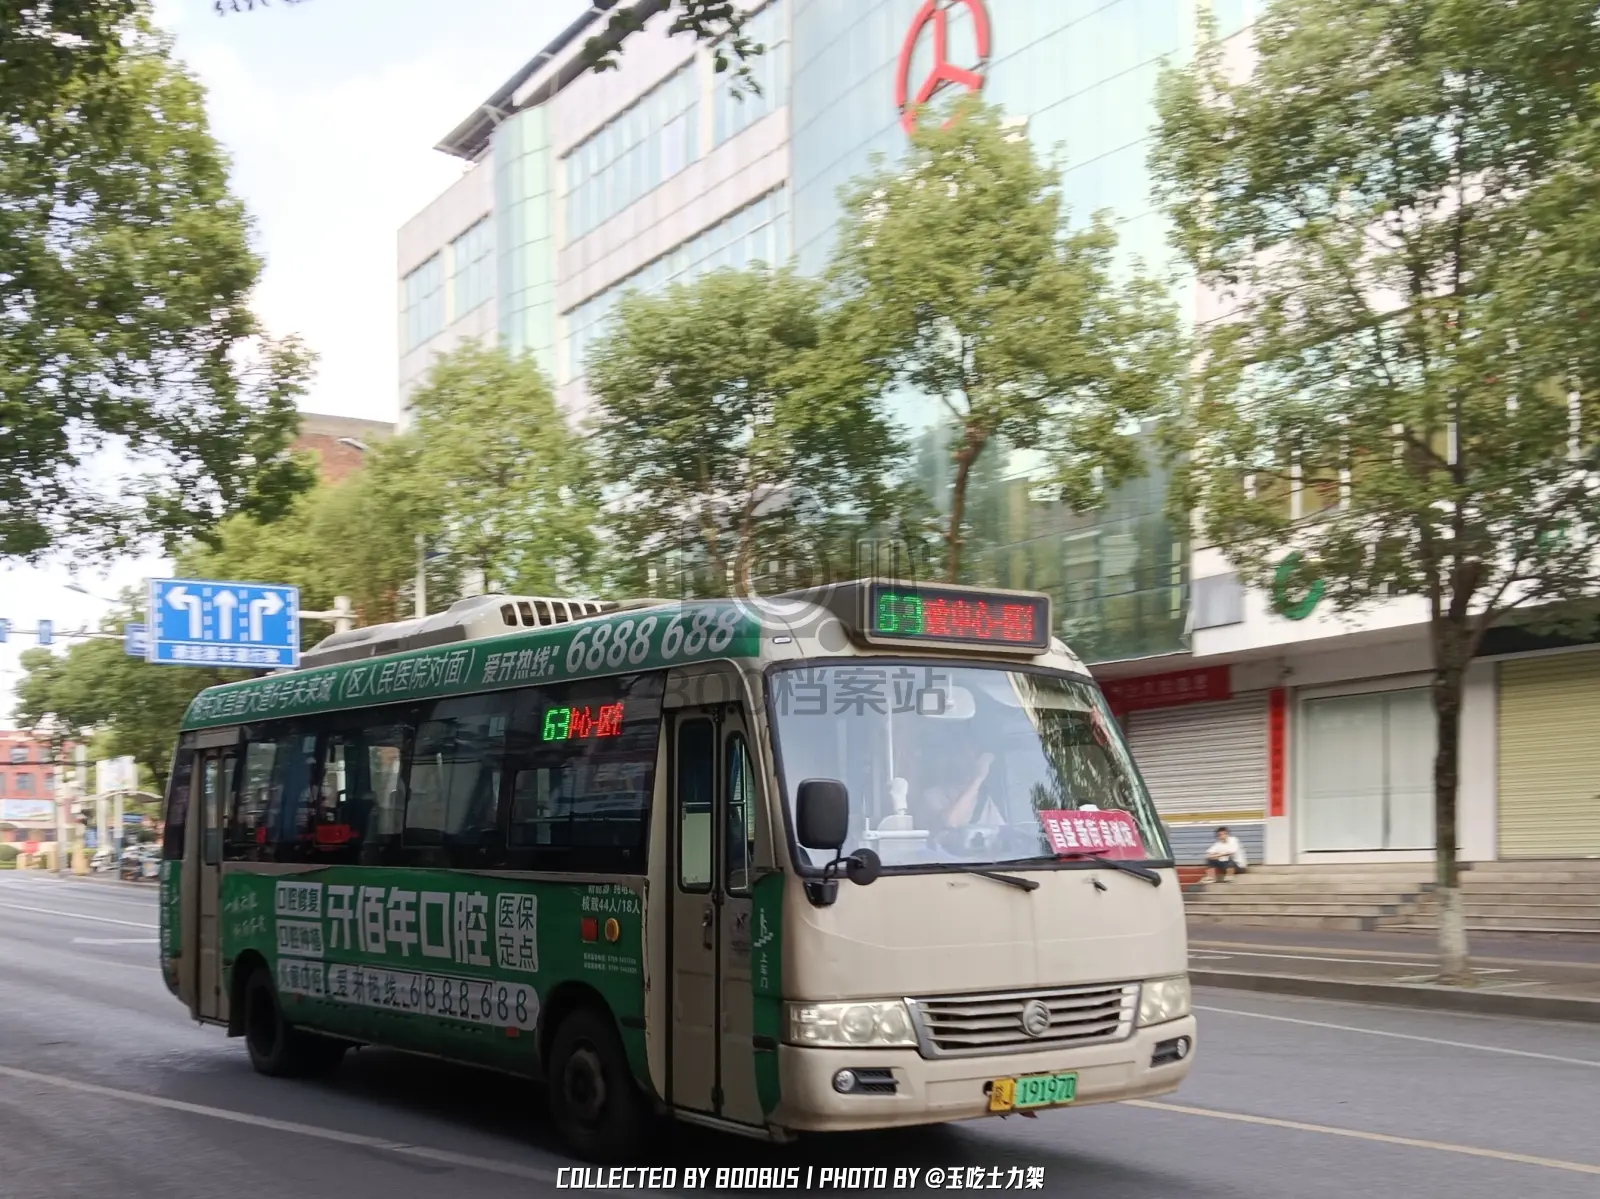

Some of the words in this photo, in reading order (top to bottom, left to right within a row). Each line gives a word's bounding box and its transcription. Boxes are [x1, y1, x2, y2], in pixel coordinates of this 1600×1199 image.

[879, 594, 923, 634] 63
[566, 615, 658, 674] 6888
[660, 606, 747, 660] 688
[543, 708, 570, 740] 63
[327, 885, 491, 967] 牙佰年口腔
[498, 895, 535, 931] 医保
[498, 933, 537, 970] 定点
